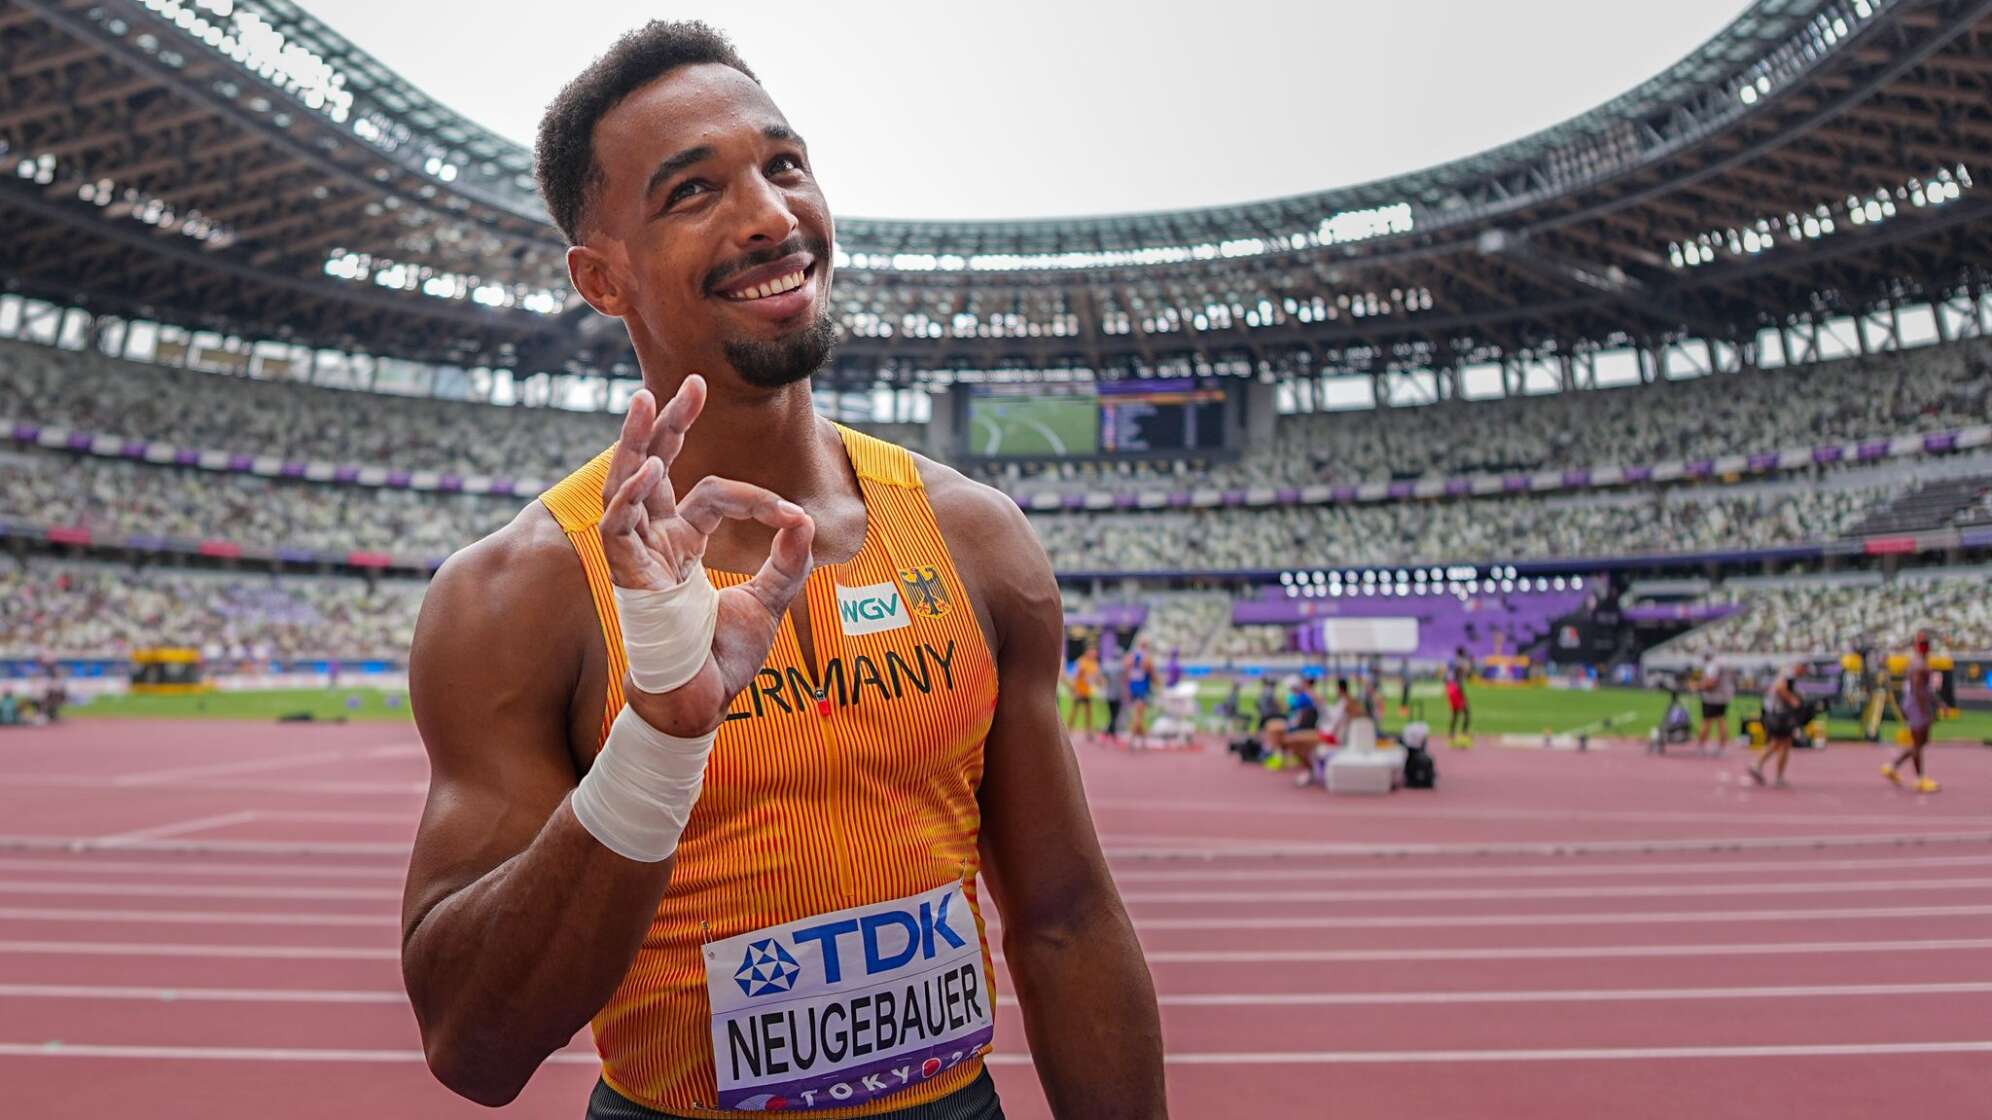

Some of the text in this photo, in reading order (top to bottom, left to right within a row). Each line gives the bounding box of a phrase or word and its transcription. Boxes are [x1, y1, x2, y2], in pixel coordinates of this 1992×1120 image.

[838, 593, 897, 623] WGV
[726, 640, 955, 721] RMANY
[792, 892, 966, 985] TDK
[727, 963, 983, 1081] NEUGEBAUER
